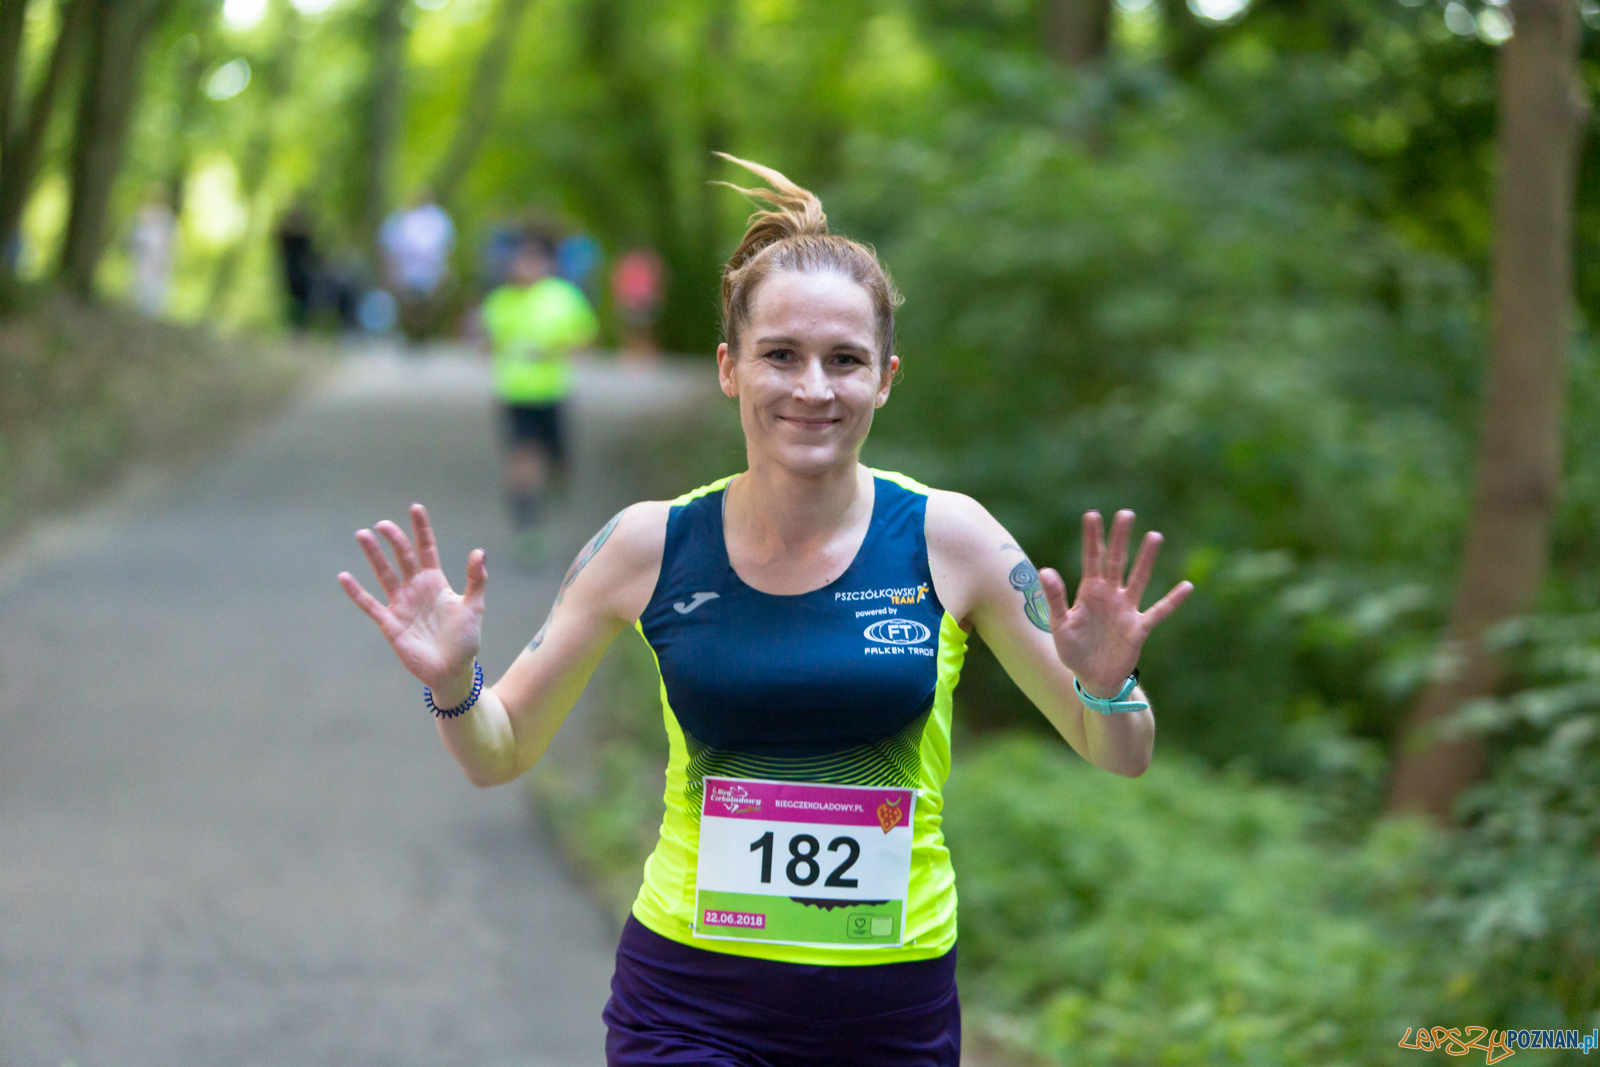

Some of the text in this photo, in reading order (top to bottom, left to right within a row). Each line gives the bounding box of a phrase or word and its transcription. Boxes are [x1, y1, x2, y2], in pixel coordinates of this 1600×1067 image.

[835, 588, 915, 600] PSZCZÓŁKOWSKI
[891, 596, 914, 604] TEAM
[855, 607, 897, 618] powered by
[887, 624, 912, 639] FT
[864, 647, 934, 656] FALKEN TRADE
[775, 799, 864, 812] BIEGCZEKOLADOWY.PL
[750, 831, 860, 888] 182
[706, 912, 763, 926] 22.06.2018
